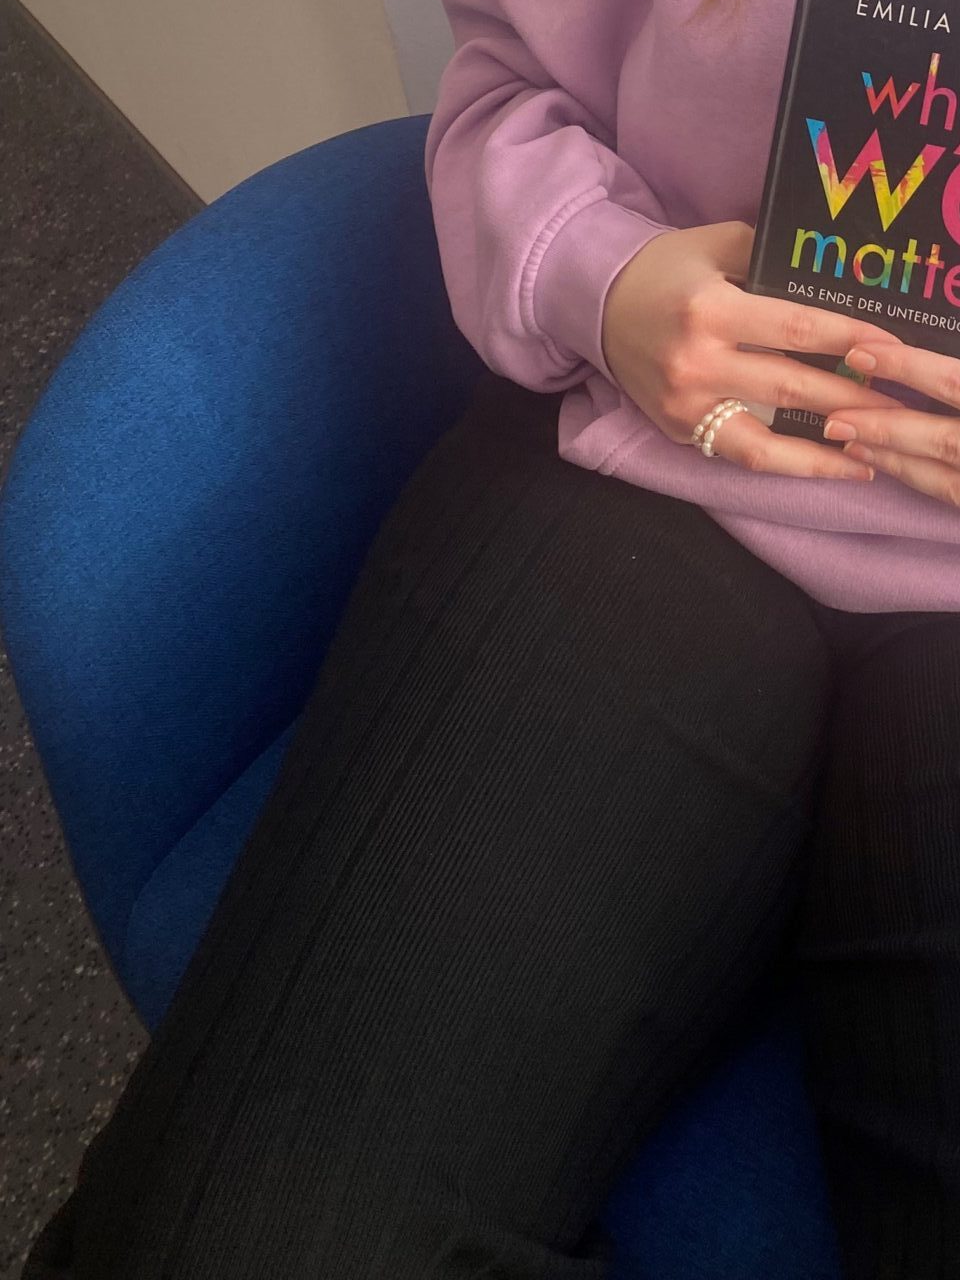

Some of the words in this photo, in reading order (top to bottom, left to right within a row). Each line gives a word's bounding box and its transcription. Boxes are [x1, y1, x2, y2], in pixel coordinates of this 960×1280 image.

[787, 281, 815, 298] DAS
[818, 286, 854, 307] ENDE
[857, 295, 884, 315] DER
